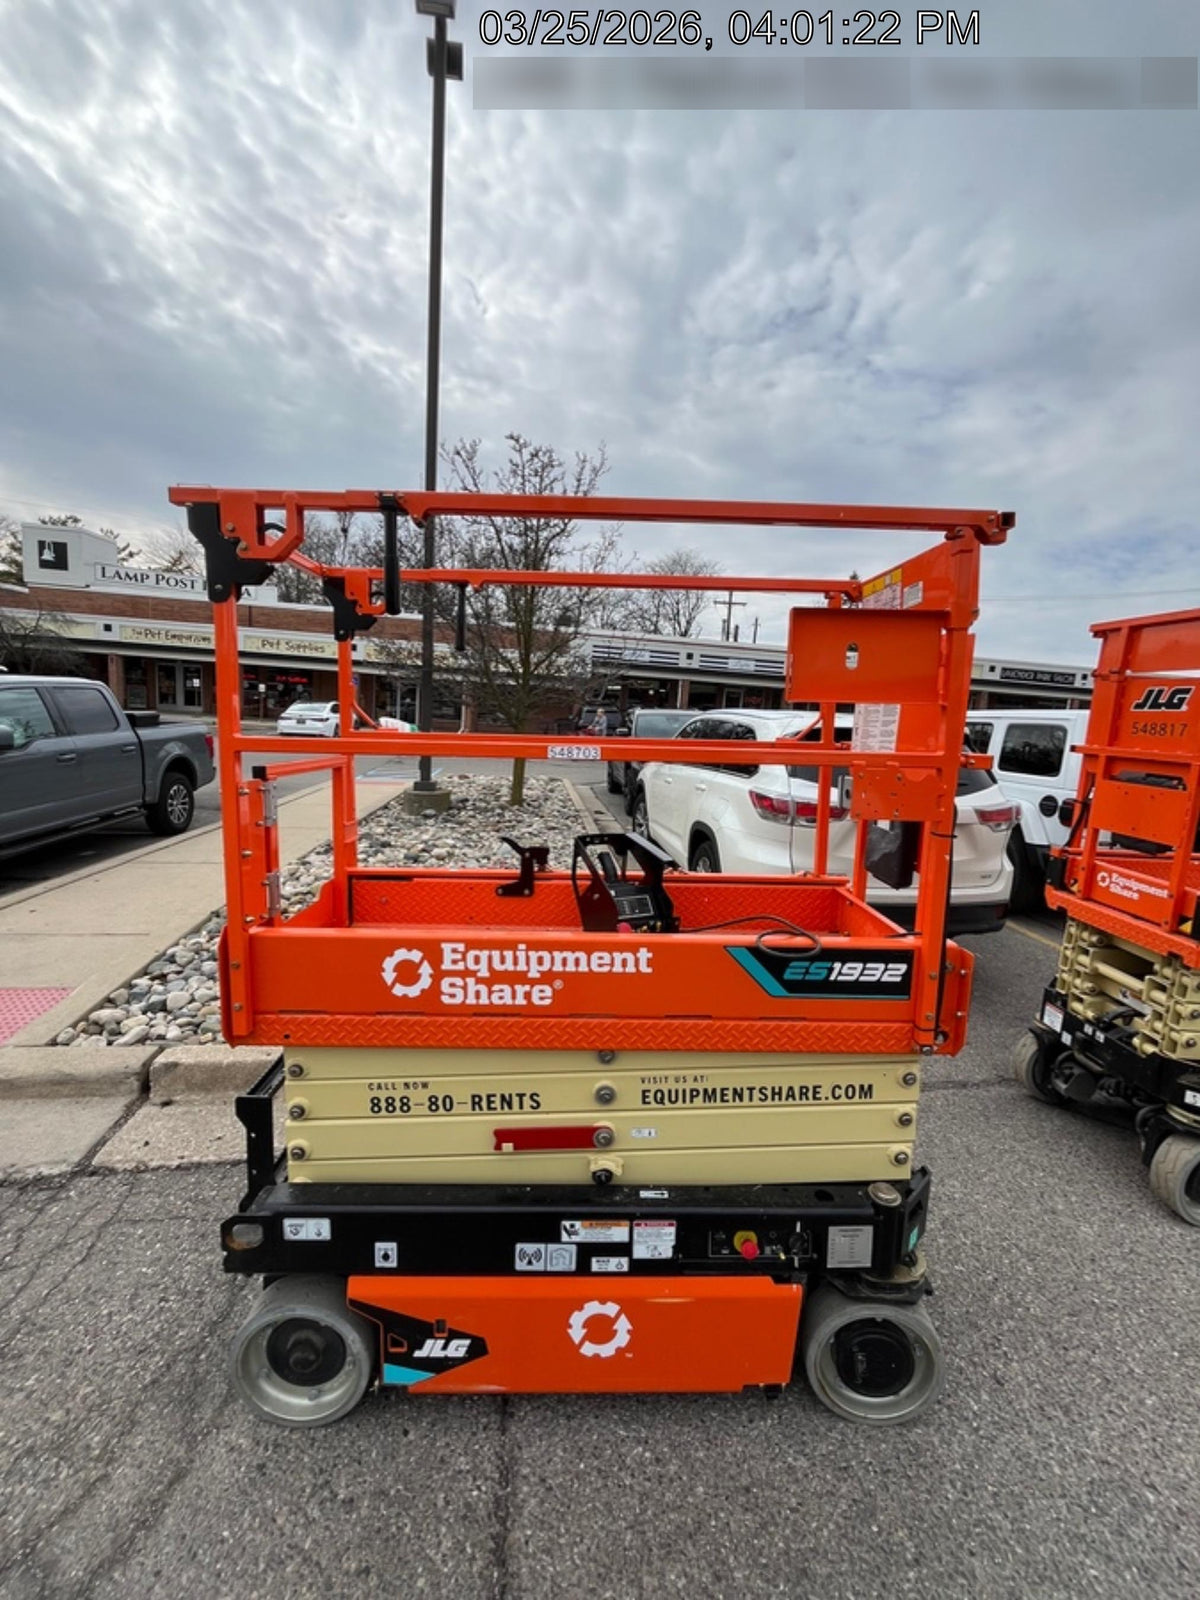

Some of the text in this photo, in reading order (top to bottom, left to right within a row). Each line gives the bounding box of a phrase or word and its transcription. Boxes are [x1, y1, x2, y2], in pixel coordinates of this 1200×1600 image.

[100, 566, 150, 584] LAMP
[155, 574, 198, 590] POST
[260, 639, 280, 650] Pet
[1130, 686, 1195, 711] JLG
[1131, 722, 1188, 737] 548817
[549, 746, 599, 758] 548703
[440, 942, 653, 978] Equipment
[783, 961, 908, 982] ES1932
[368, 1081, 430, 1091] CALL NOW
[640, 1076, 669, 1085] VISIT
[674, 1075, 688, 1084] US
[369, 1092, 541, 1114] 888-80-RENTS
[641, 1083, 874, 1105] EQUIPMENTSHARE.COM
[412, 1338, 471, 1357] JLG
